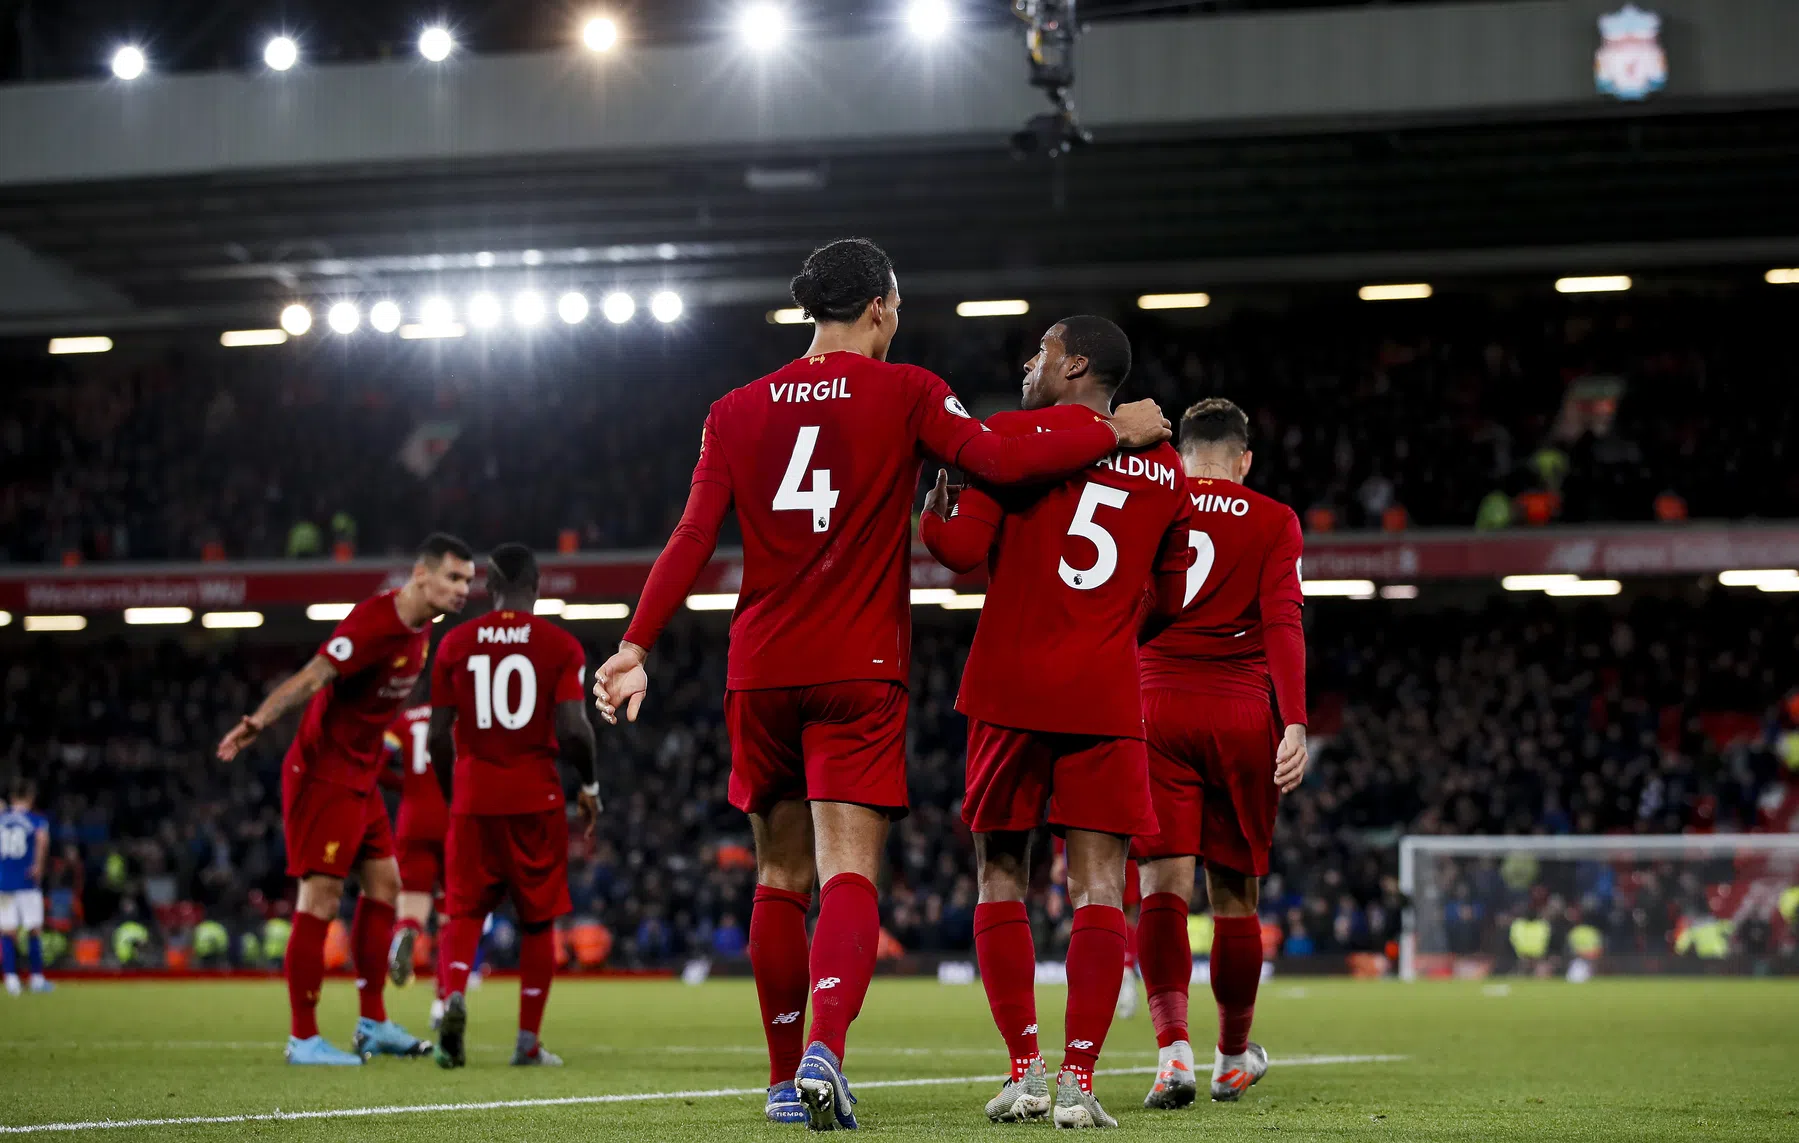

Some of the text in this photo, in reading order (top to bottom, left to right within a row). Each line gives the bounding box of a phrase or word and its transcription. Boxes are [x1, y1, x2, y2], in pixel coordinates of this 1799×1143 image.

[769, 377, 852, 403] VIRGIL
[772, 425, 840, 533] 4
[1096, 451, 1176, 490] ALDUM
[1189, 492, 1250, 517] MINO
[1058, 481, 1130, 590] 5
[477, 623, 532, 644] MANÉ
[467, 653, 538, 730] 10
[410, 720, 432, 775] 1
